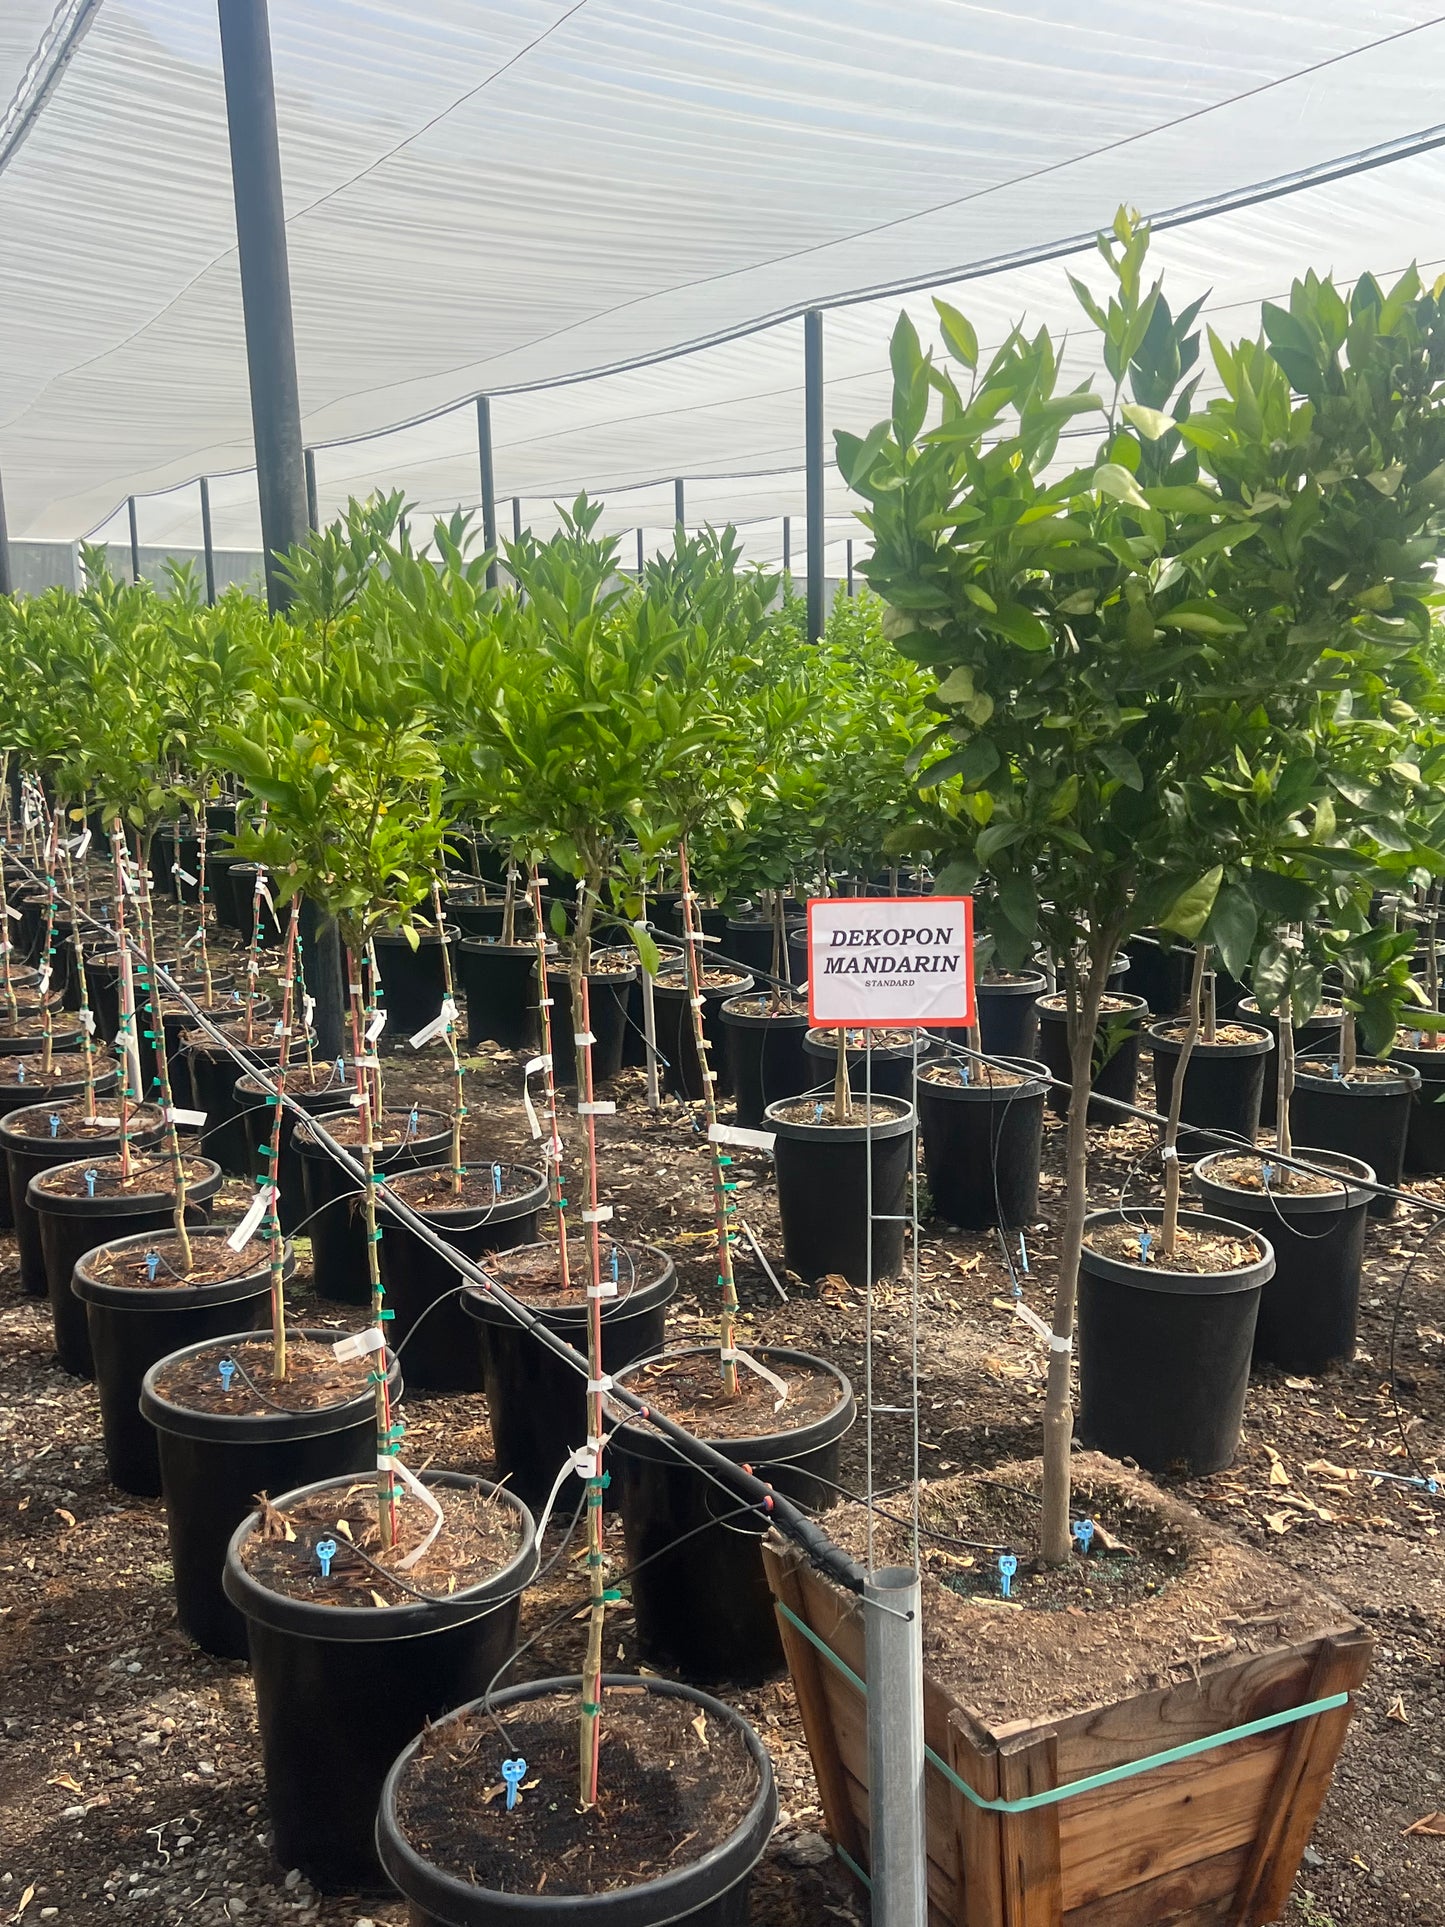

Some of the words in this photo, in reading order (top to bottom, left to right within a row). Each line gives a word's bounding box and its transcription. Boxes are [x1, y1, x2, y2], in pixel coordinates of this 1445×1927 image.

[829, 927, 954, 947] DEKOPON
[823, 955, 960, 974] MANDARIN
[864, 979, 915, 987] STANDARD
